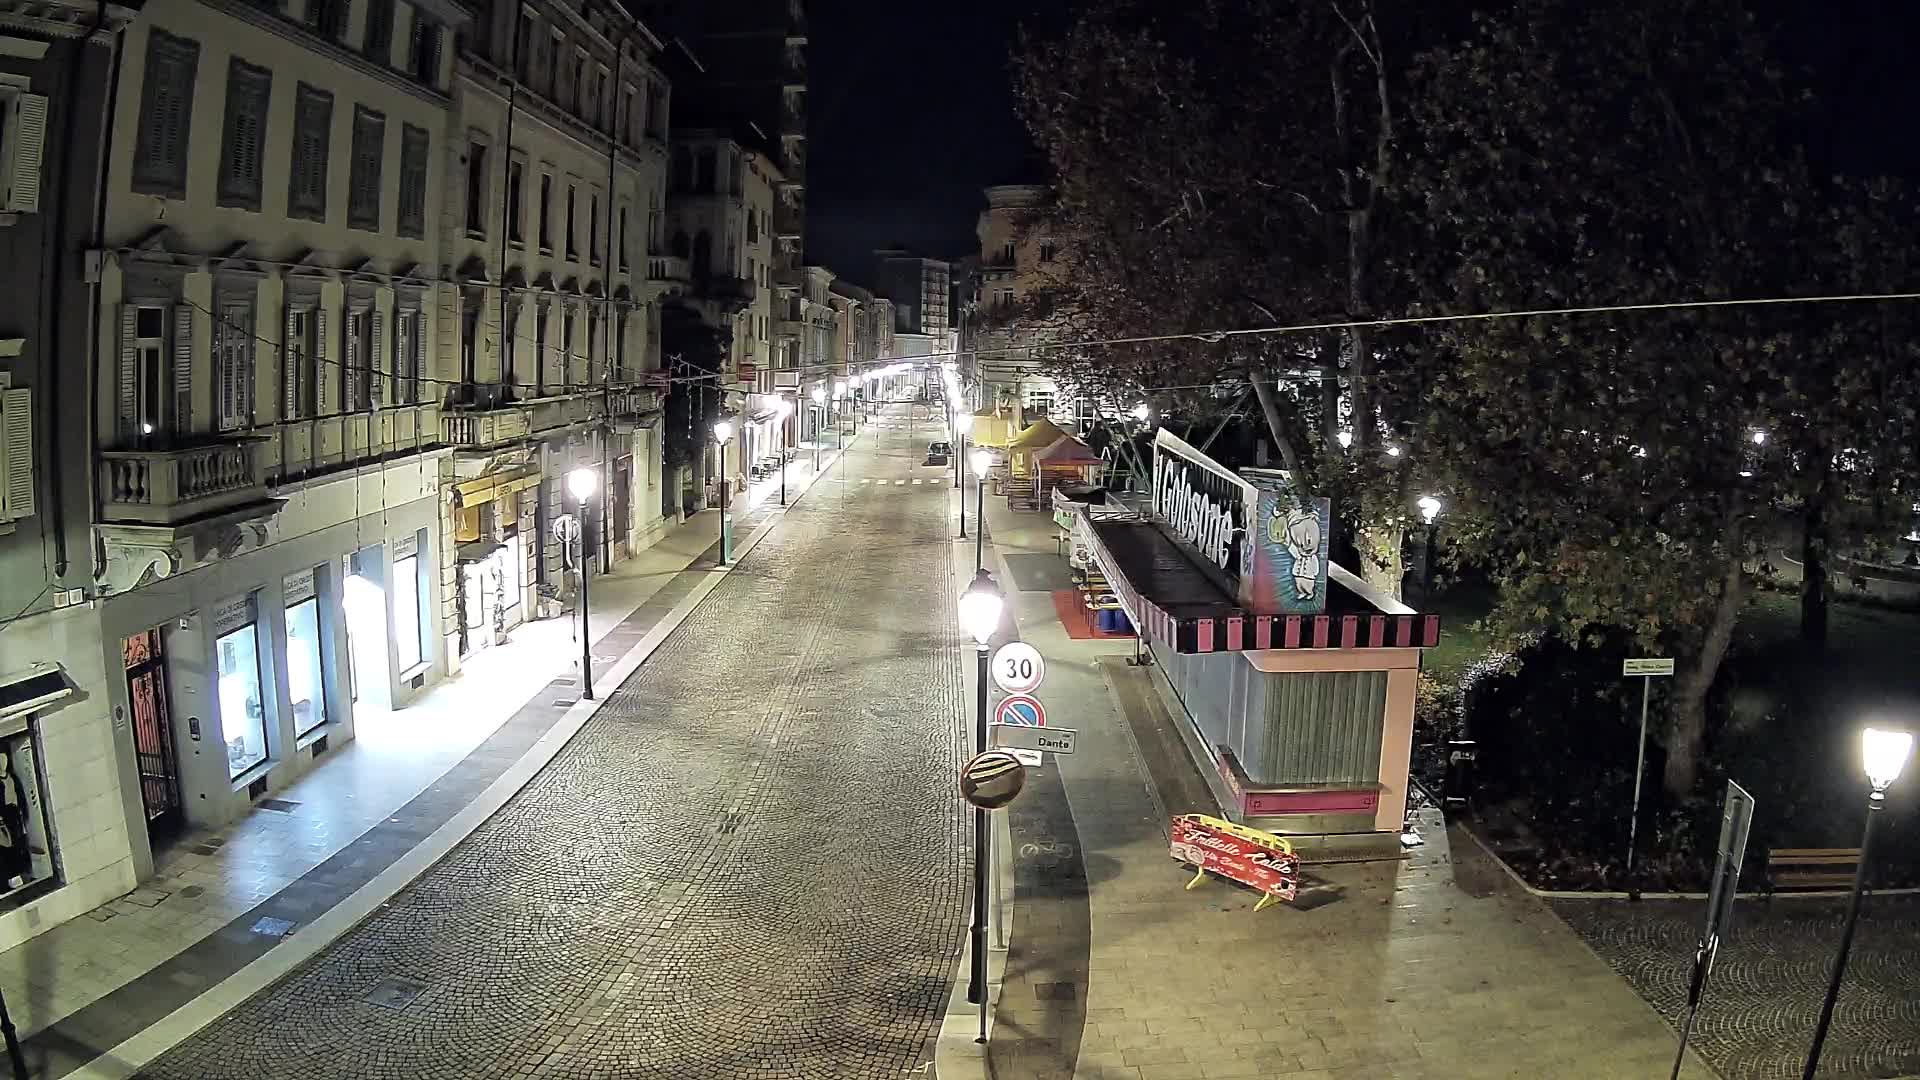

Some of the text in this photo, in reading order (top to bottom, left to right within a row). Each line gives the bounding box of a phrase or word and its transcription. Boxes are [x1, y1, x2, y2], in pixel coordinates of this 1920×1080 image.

[1162, 458, 1233, 570] Golosone
[1006, 658, 1032, 679] 30
[1038, 737, 1069, 749] Dante
